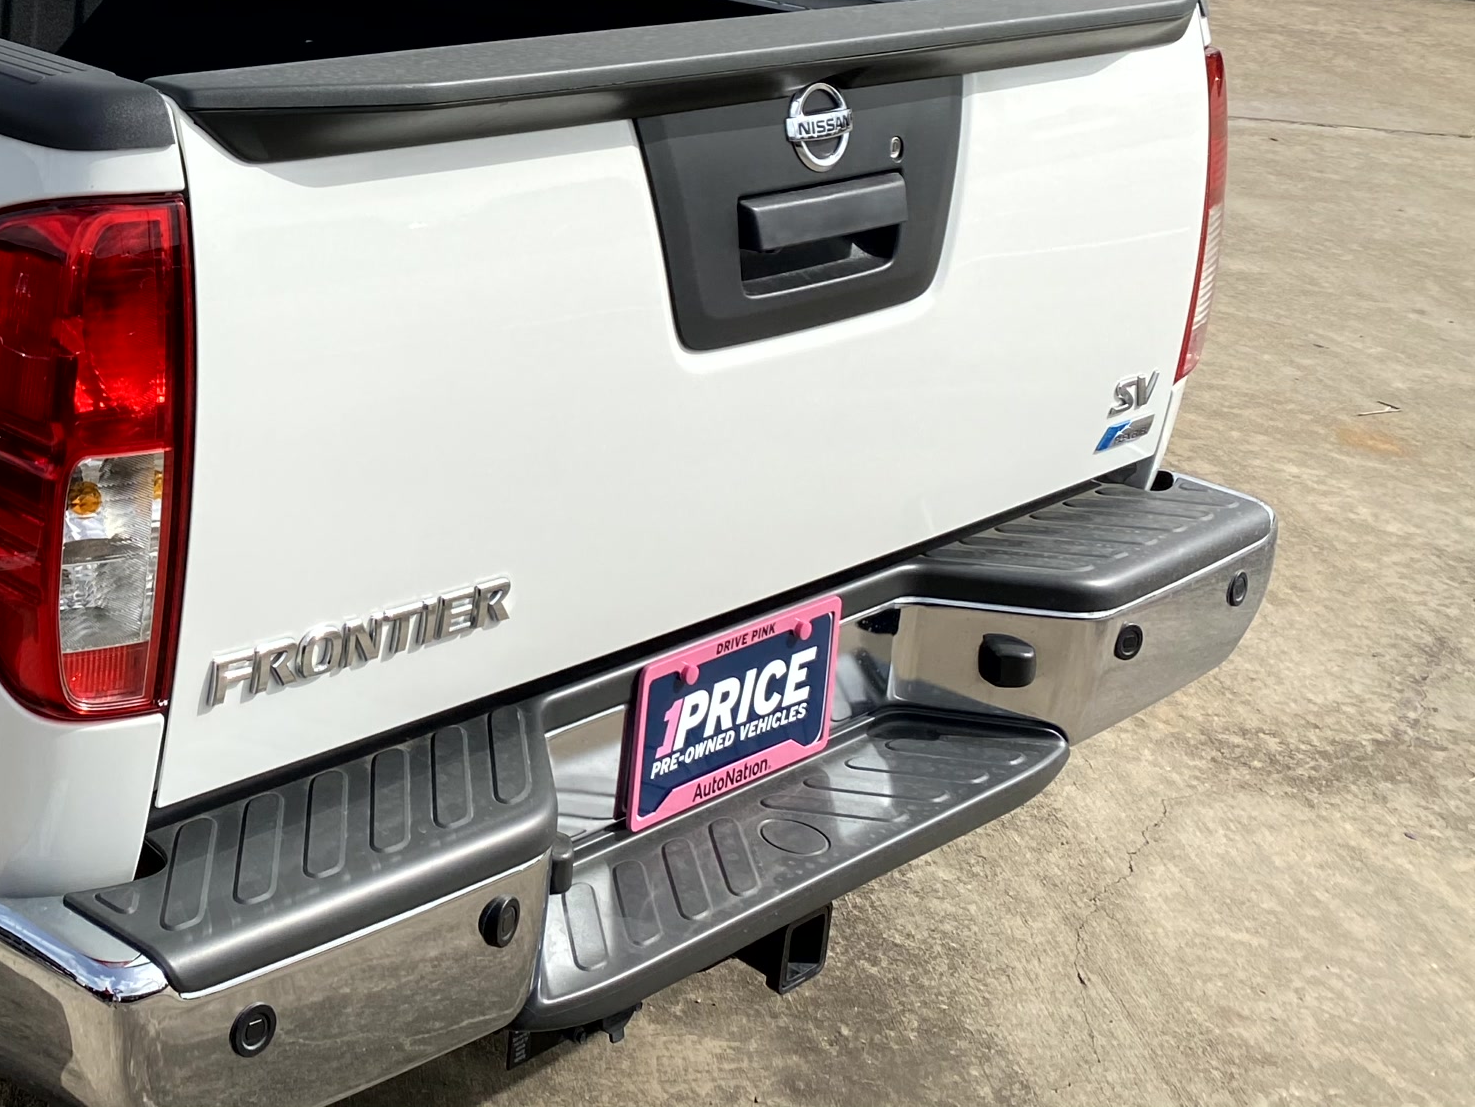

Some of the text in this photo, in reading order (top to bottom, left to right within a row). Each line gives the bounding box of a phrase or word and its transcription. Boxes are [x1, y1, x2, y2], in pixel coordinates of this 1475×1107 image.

[798, 115, 850, 136] NISSAN
[1107, 370, 1160, 419] SV
[205, 576, 511, 707] FRONTIER
[716, 623, 776, 655] DRIVE PINK
[655, 646, 818, 759] 1PRICE
[650, 702, 808, 779] PRE-OWNED VEHICLES
[692, 759, 768, 802] AutoNation
